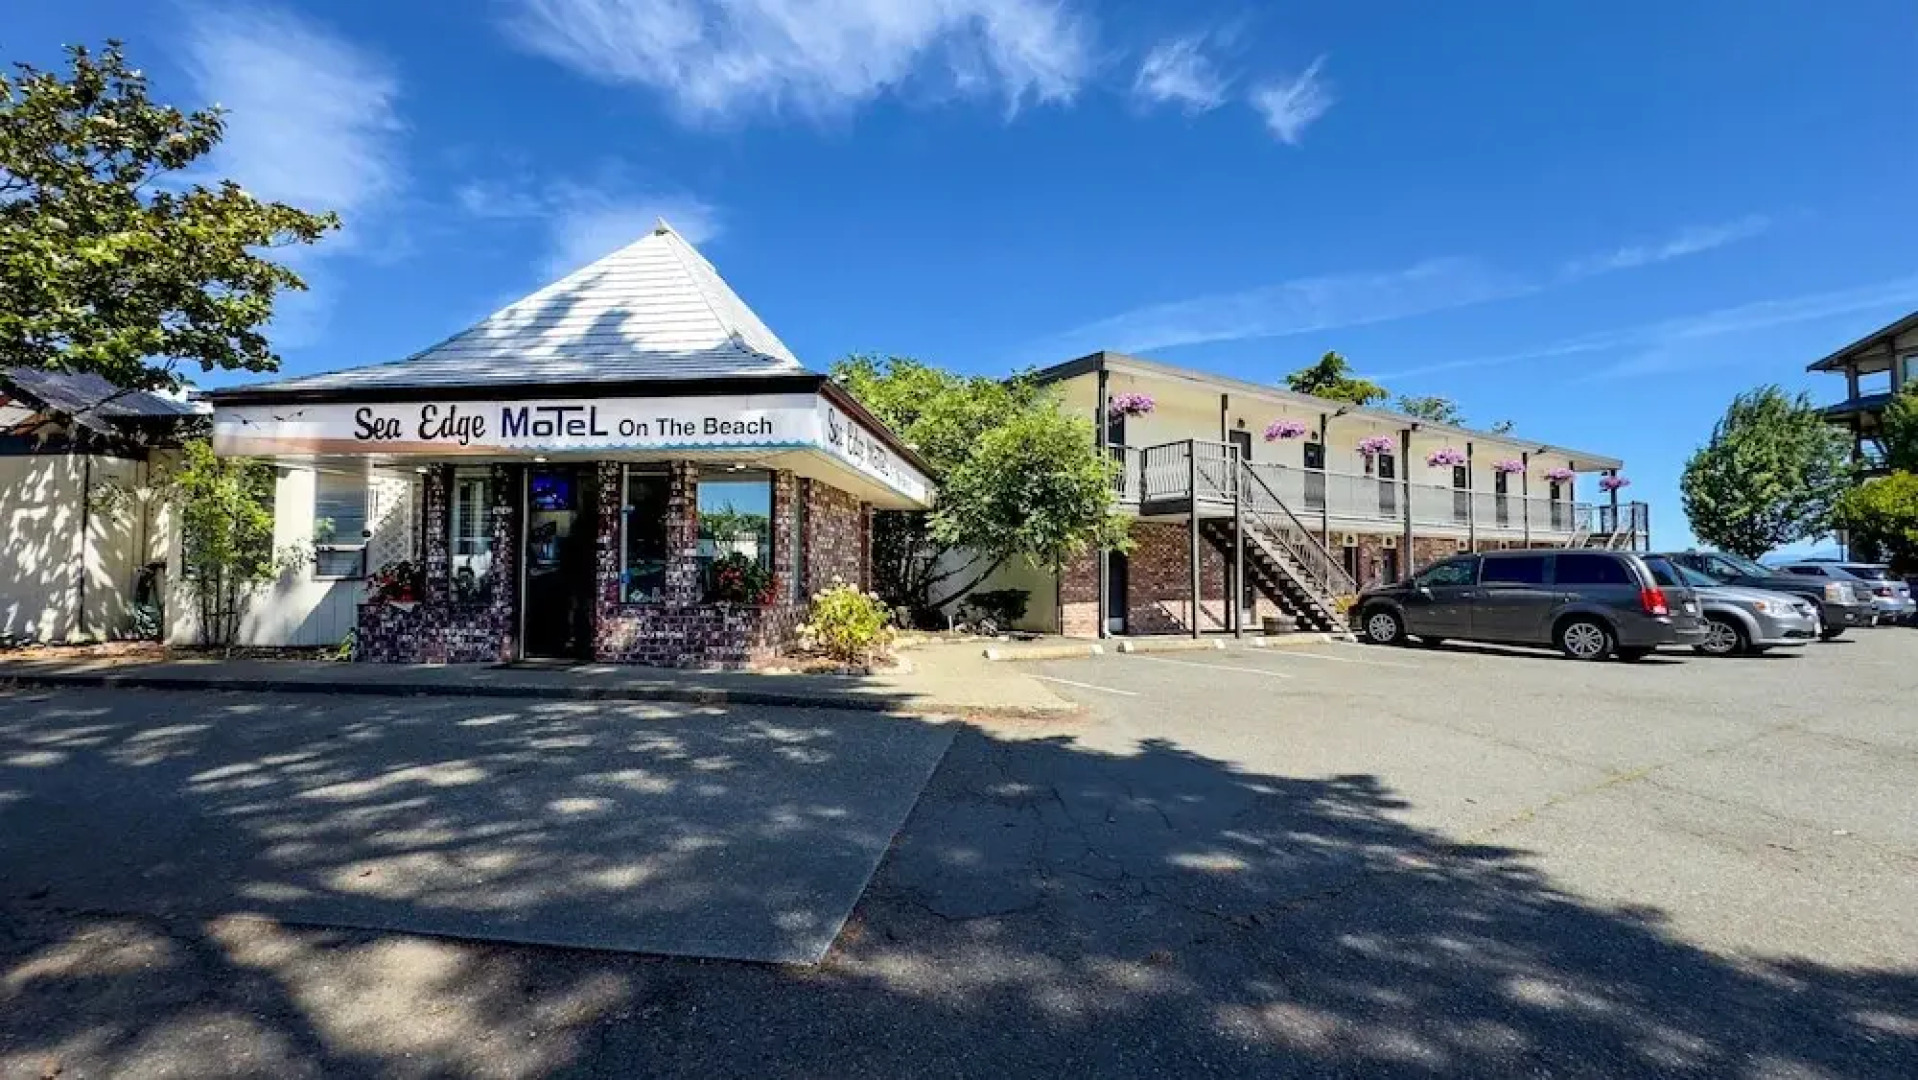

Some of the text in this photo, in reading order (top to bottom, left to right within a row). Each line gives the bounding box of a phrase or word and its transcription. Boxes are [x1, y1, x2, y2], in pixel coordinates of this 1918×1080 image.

[354, 406, 402, 440] Sea
[418, 404, 486, 446] Edge
[618, 419, 649, 437] On
[655, 418, 696, 436] The
[703, 416, 772, 435] Beach
